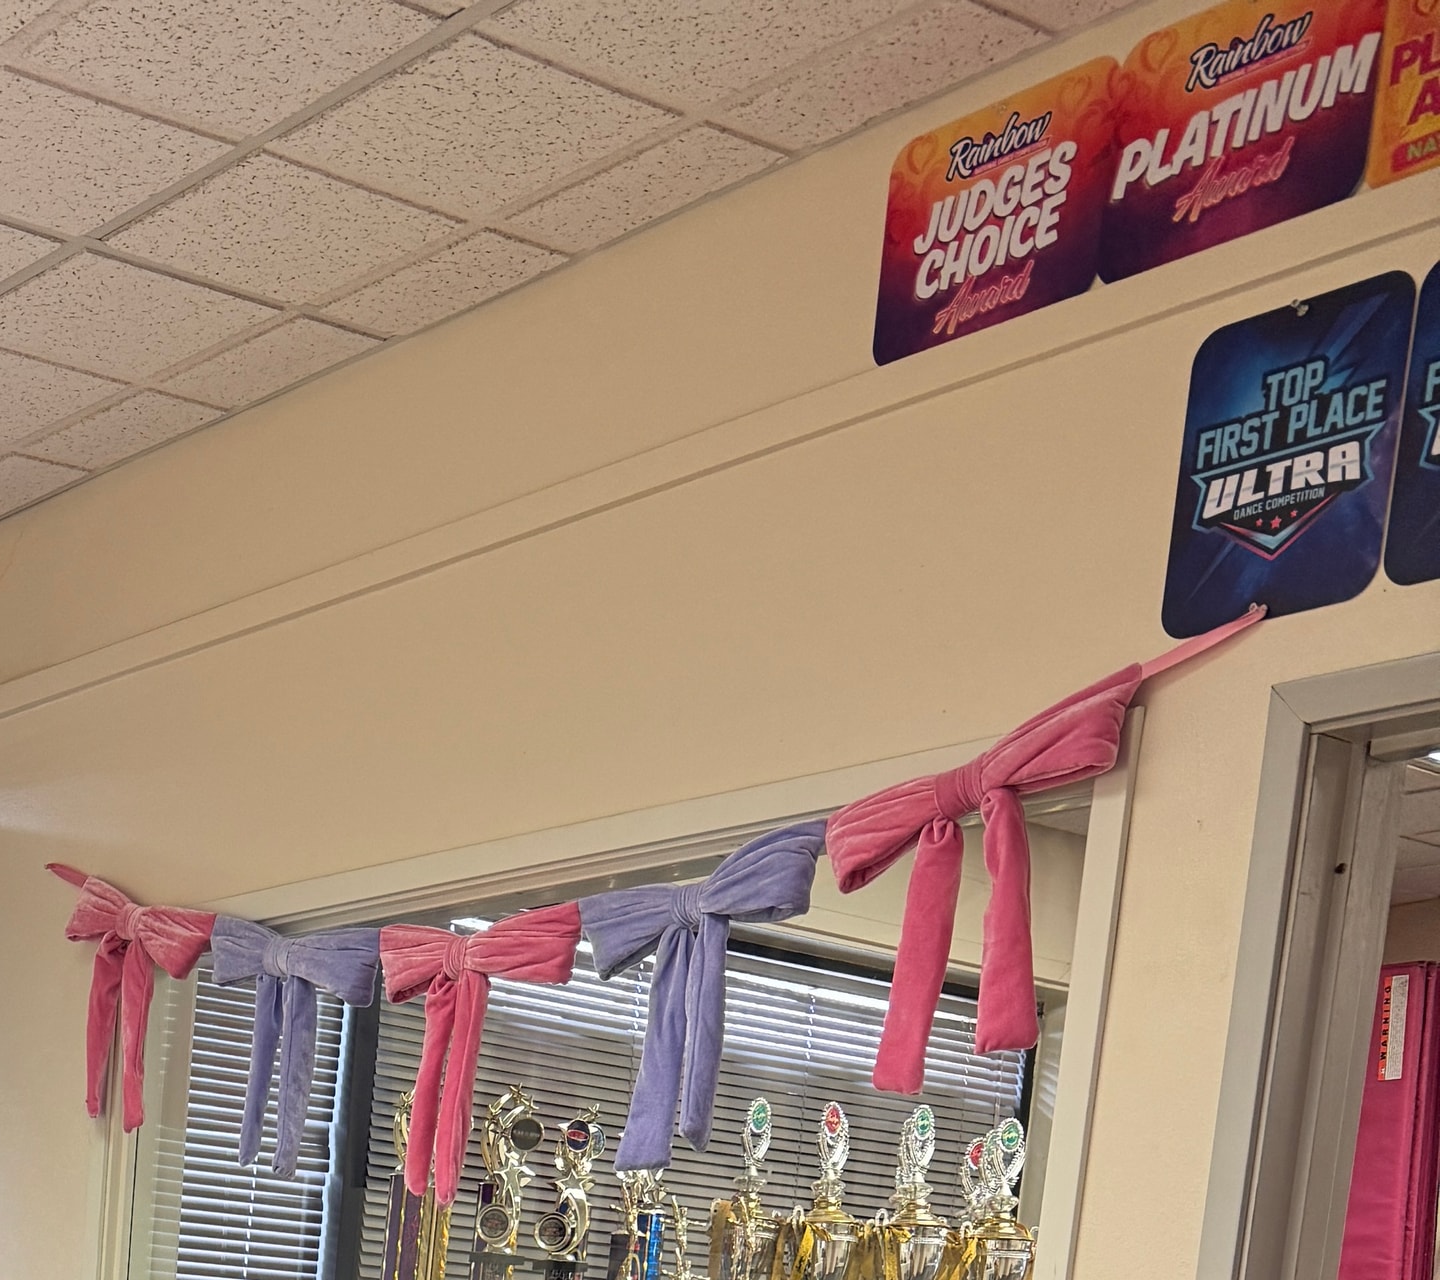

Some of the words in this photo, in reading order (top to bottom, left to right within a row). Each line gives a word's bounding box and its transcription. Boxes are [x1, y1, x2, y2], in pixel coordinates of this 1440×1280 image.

[1185, 10, 1313, 93] Rainbow
[945, 111, 1053, 182] Rainbow
[1112, 32, 1382, 201] PLATINUM
[913, 140, 1078, 255] JUDGES
[1172, 135, 1296, 223] Award
[915, 190, 1067, 300] CHOICE
[932, 259, 1035, 335] Award
[1196, 411, 1280, 470] FIRST
[1286, 378, 1388, 444] PLACE
[1266, 360, 1326, 411] TOP
[1202, 440, 1361, 520] ULTRA
[1233, 503, 1263, 521] DANCE
[1265, 486, 1326, 511] COMPETITION
[1380, 986, 1392, 1060] WARNING
